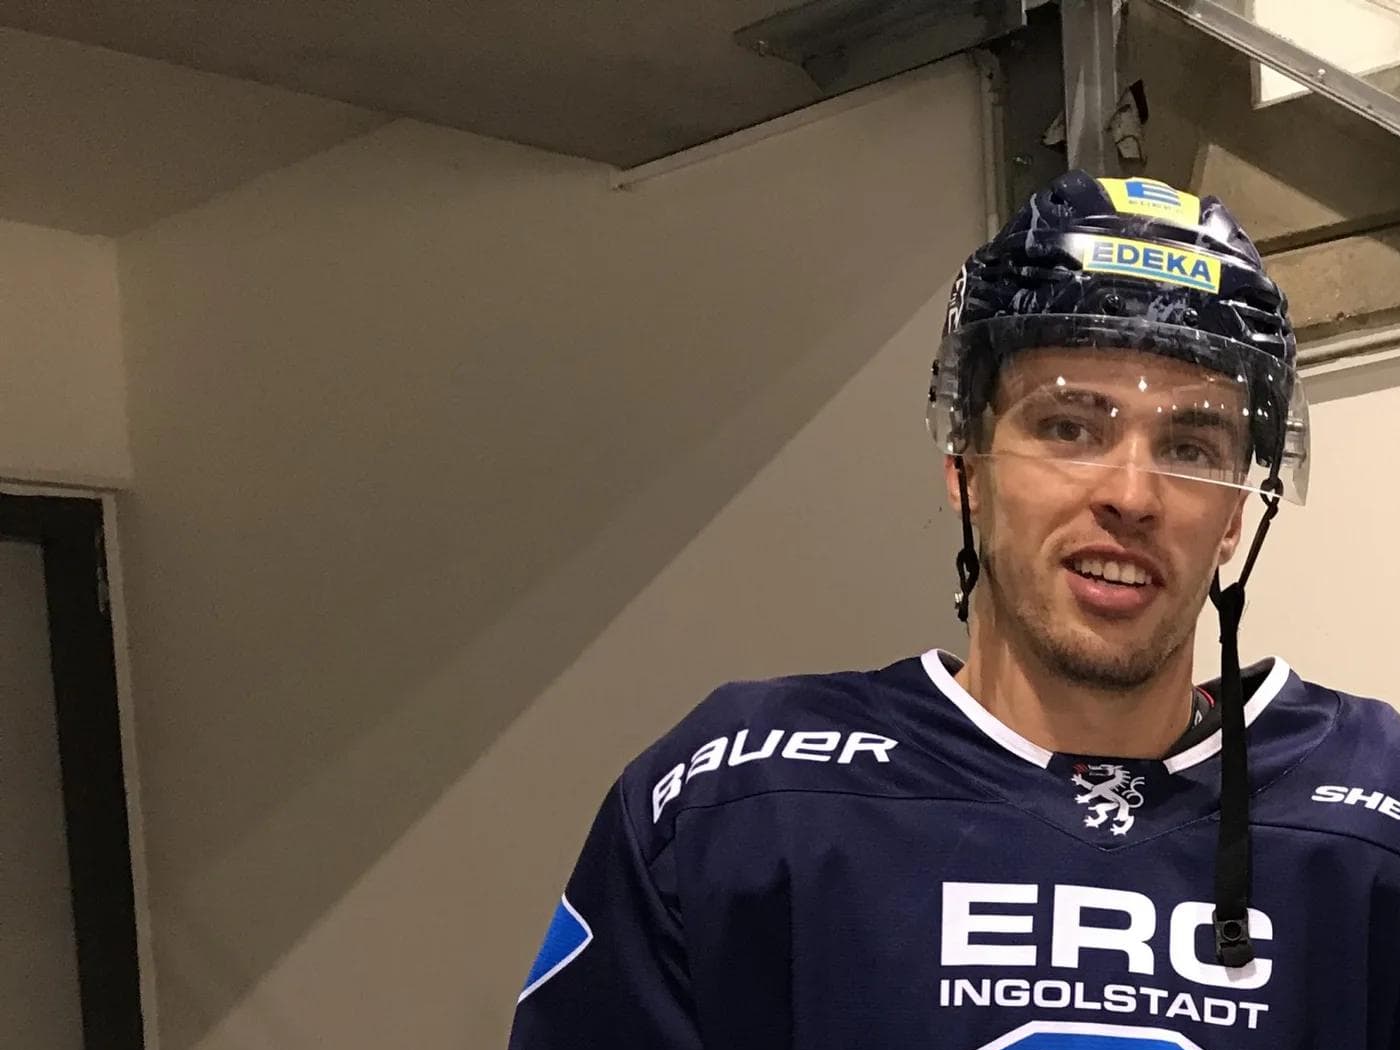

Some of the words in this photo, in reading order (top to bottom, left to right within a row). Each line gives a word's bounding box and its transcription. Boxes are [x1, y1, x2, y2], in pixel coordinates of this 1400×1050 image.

[1092, 240, 1212, 283] EDEKA
[940, 881, 1274, 990] ERC
[939, 978, 1270, 1030] INGOLSTADT
